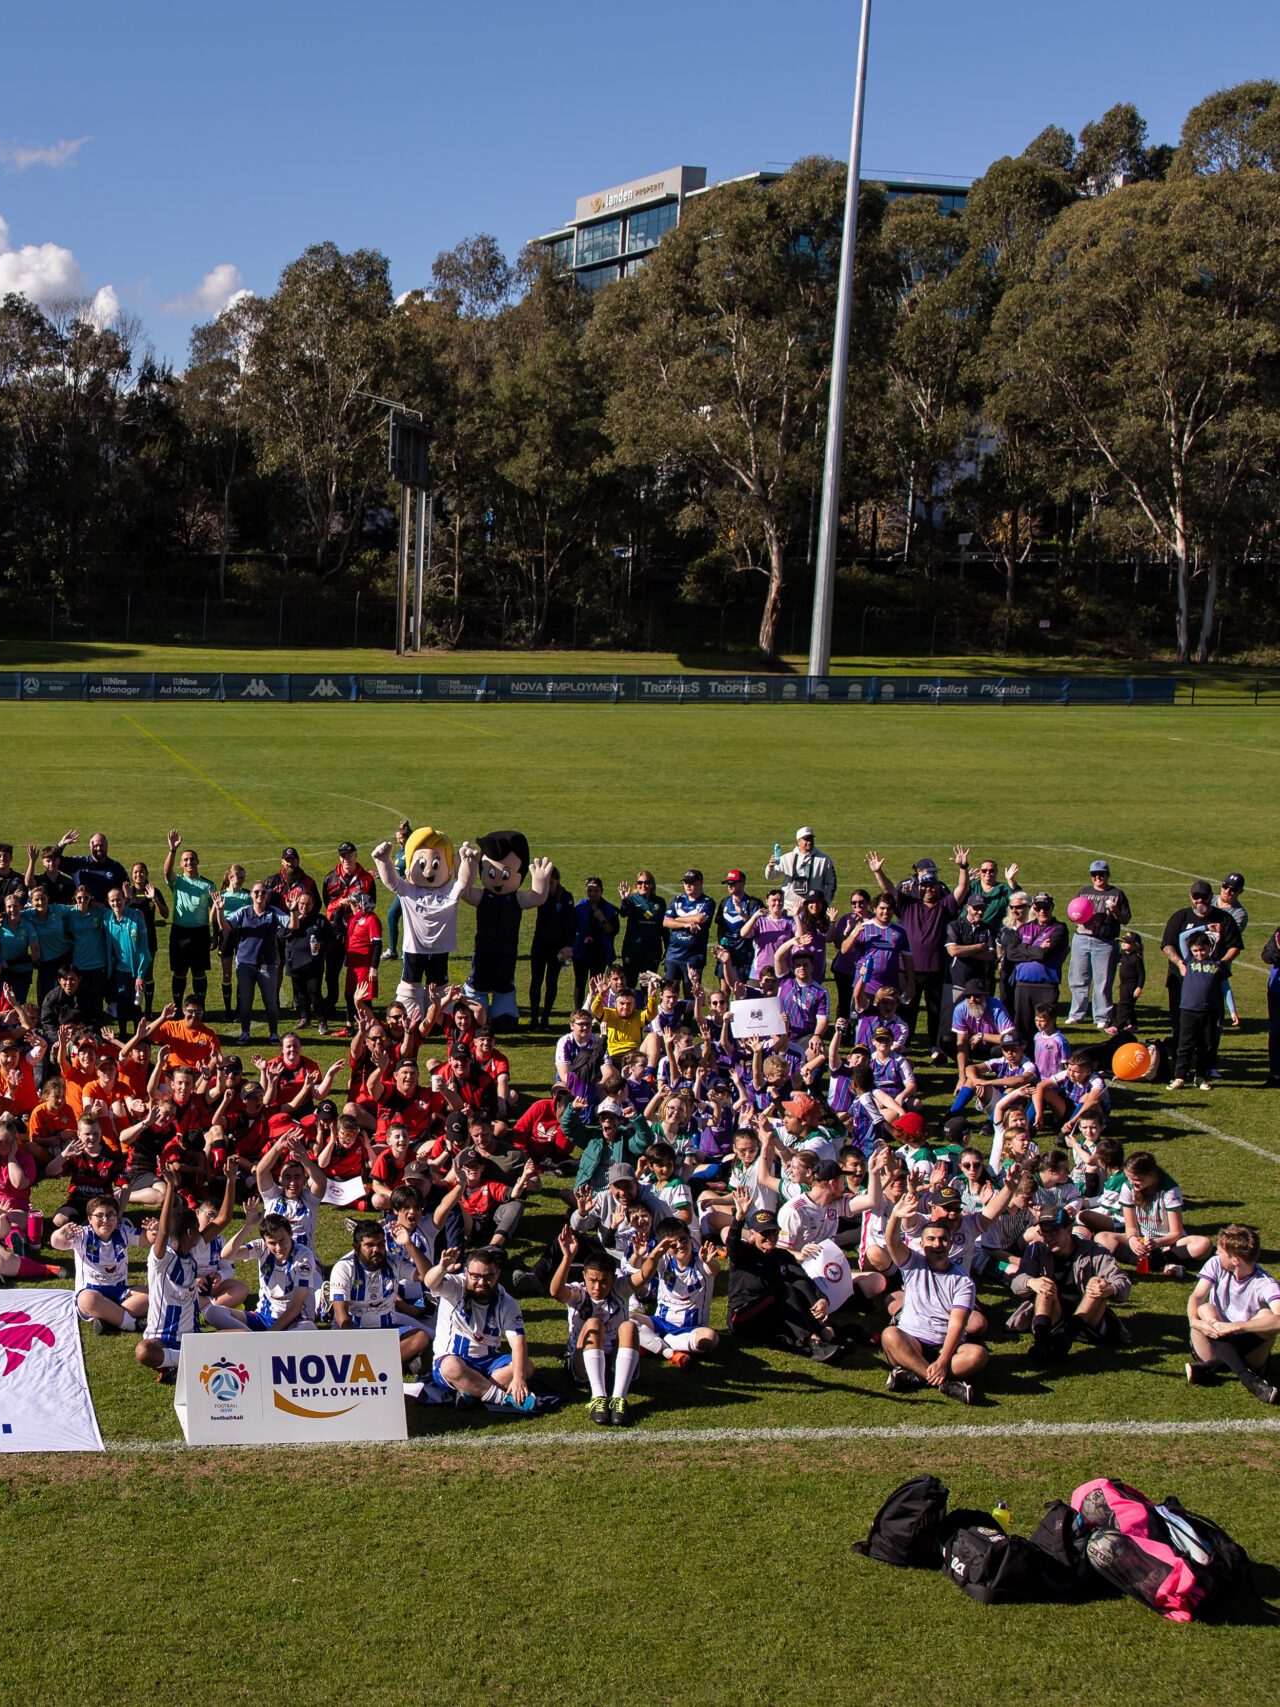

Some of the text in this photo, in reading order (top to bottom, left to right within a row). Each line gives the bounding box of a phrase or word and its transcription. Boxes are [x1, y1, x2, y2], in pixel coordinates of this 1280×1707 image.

[605, 181, 664, 207] landen PROPERTY
[103, 687, 140, 695] Manager
[173, 687, 210, 695] Manager
[511, 682, 625, 692] NOVA EMPLOYMENT
[642, 682, 700, 693] TROPHIES
[708, 682, 767, 693] TROPHIES
[918, 684, 968, 694] Pixellot
[980, 684, 1031, 694] Pixellot
[271, 1354, 388, 1385] NOVA.
[292, 1386, 388, 1398] EMPLOYMENT
